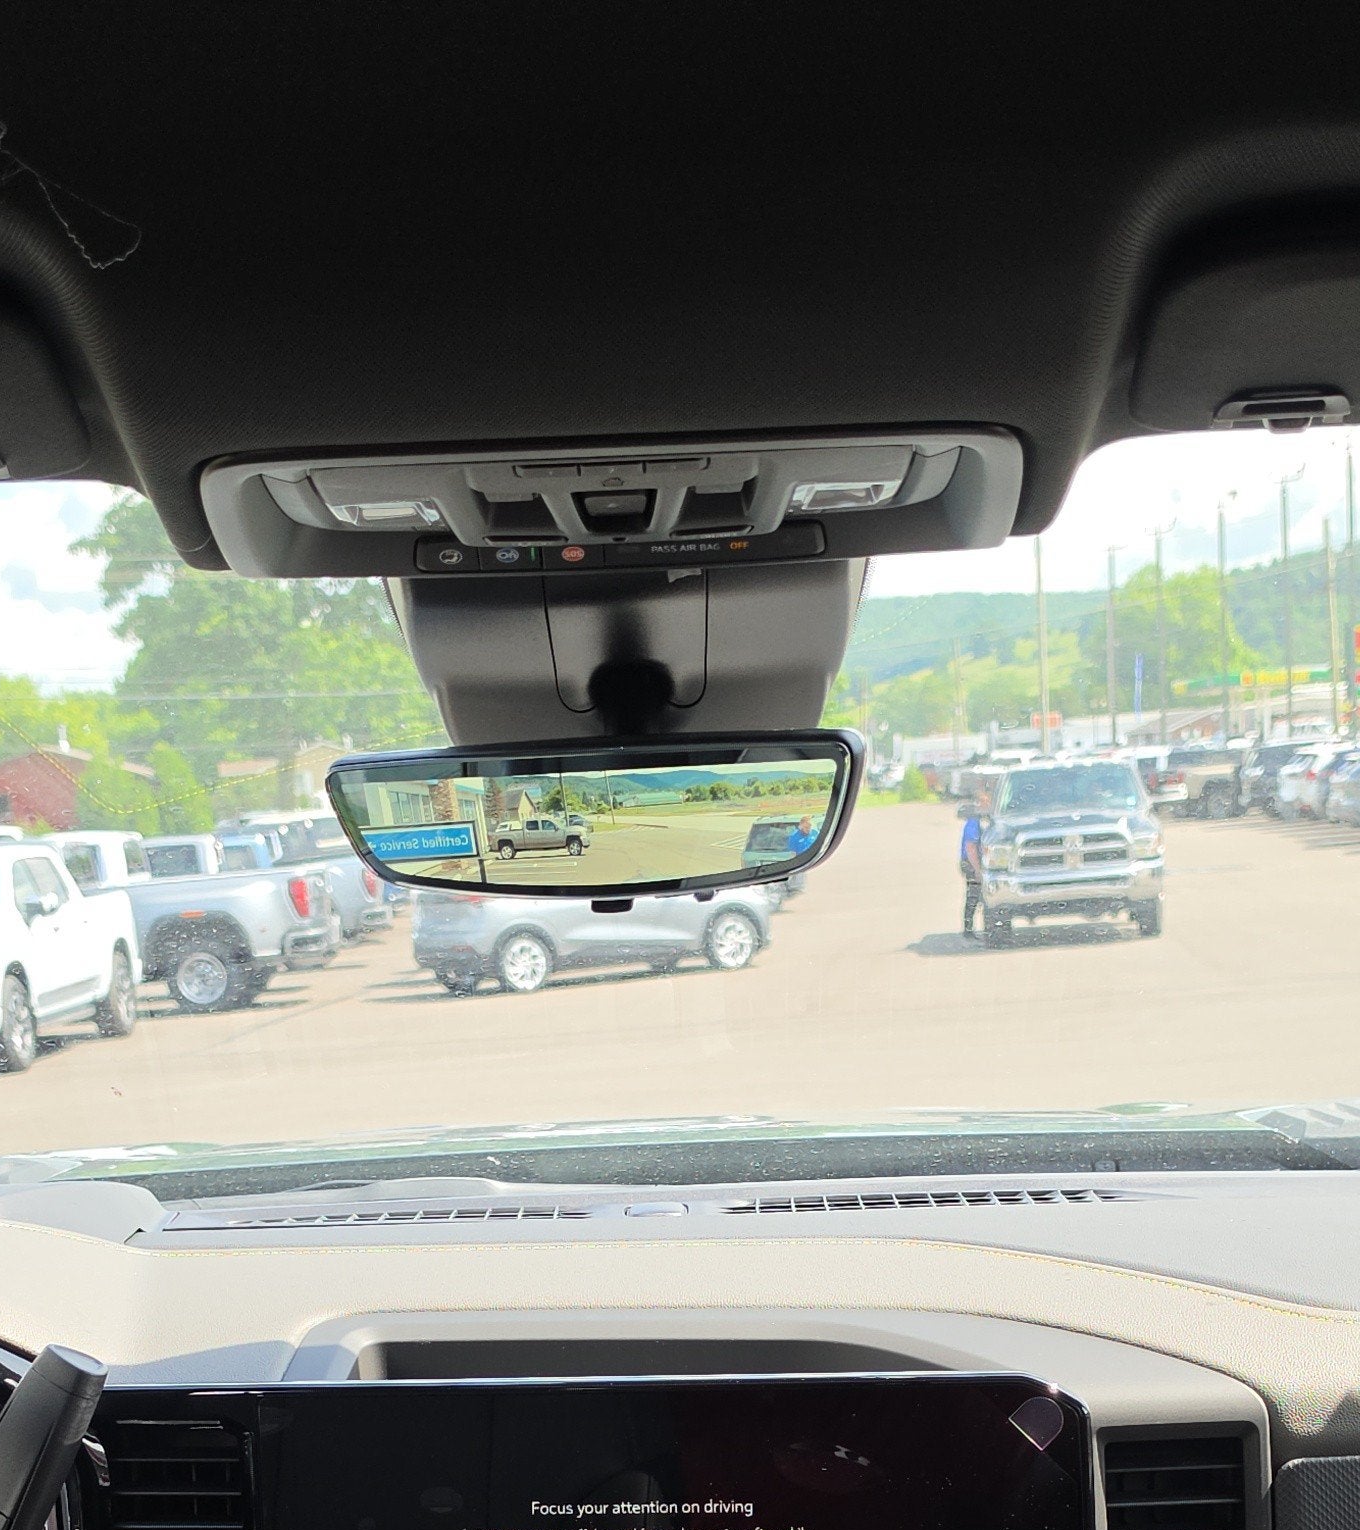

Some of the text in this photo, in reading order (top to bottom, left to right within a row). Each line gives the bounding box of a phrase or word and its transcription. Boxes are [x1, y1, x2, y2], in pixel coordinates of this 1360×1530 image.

[650, 541, 750, 554] PASS AIR BAG OFF
[531, 1499, 754, 1518] Focus your attention on driving
